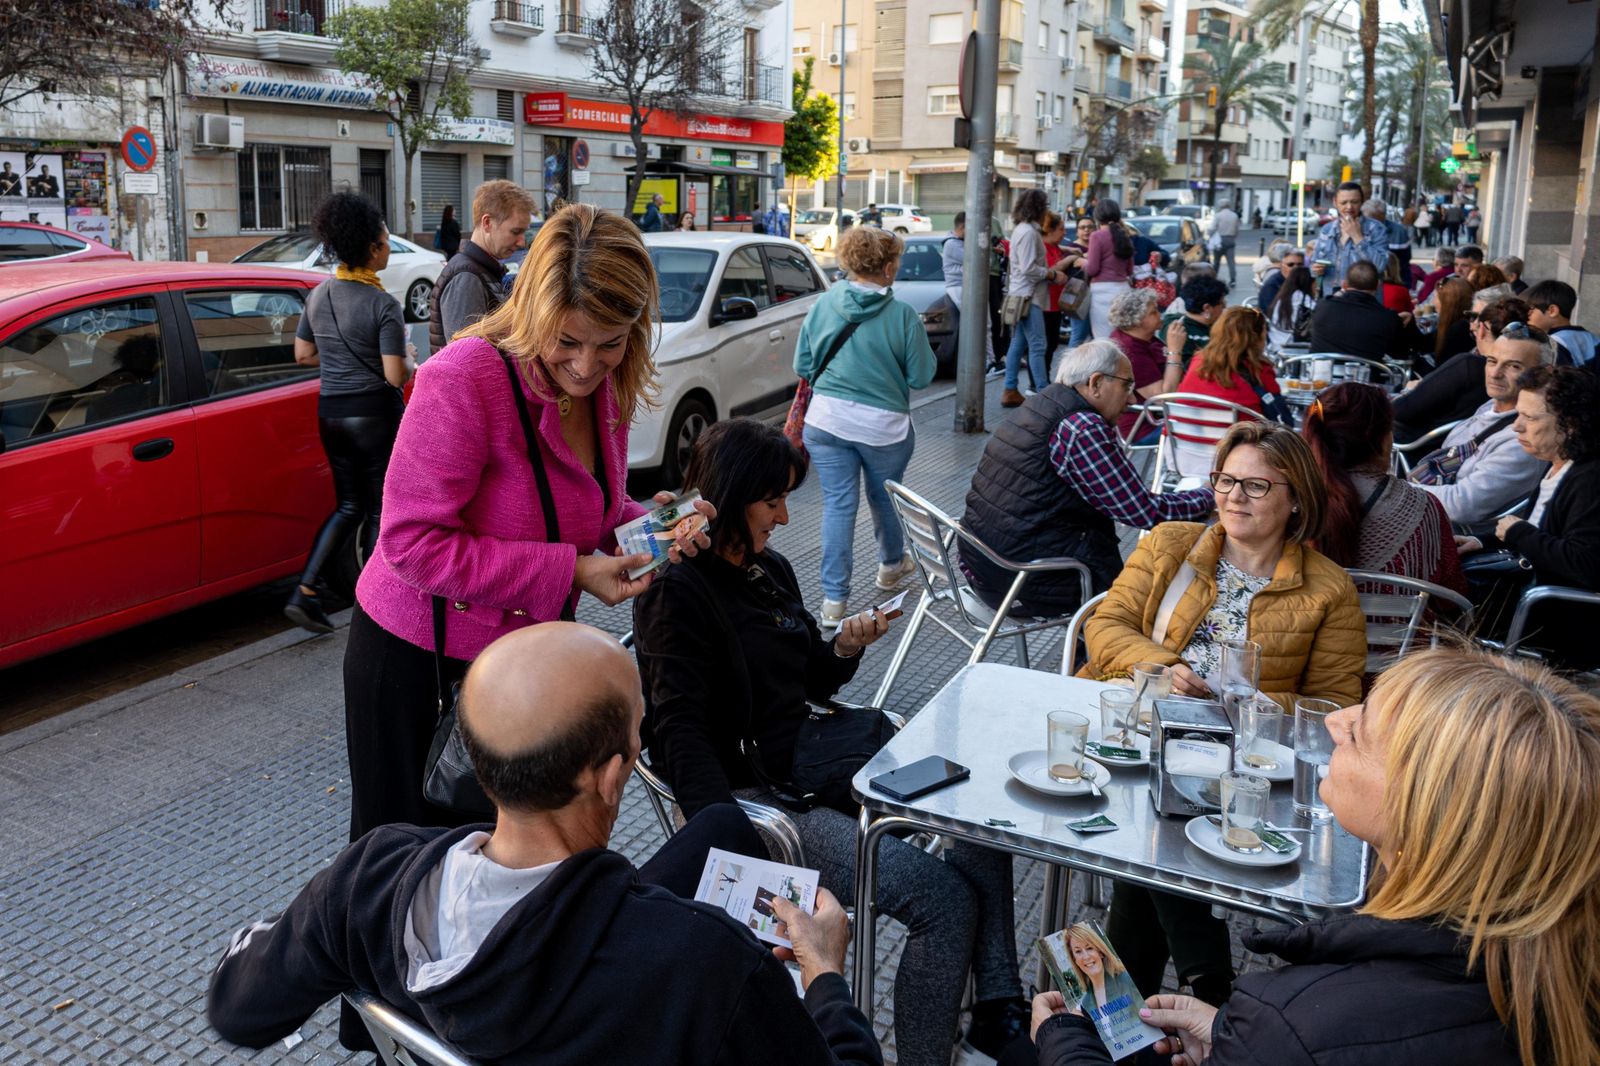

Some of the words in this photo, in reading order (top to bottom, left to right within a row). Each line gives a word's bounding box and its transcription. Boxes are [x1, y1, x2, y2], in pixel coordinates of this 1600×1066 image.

[240, 80, 324, 101] ALIMENTACION
[326, 88, 372, 106] AVENIDA
[572, 108, 620, 124] COMERCIAL
